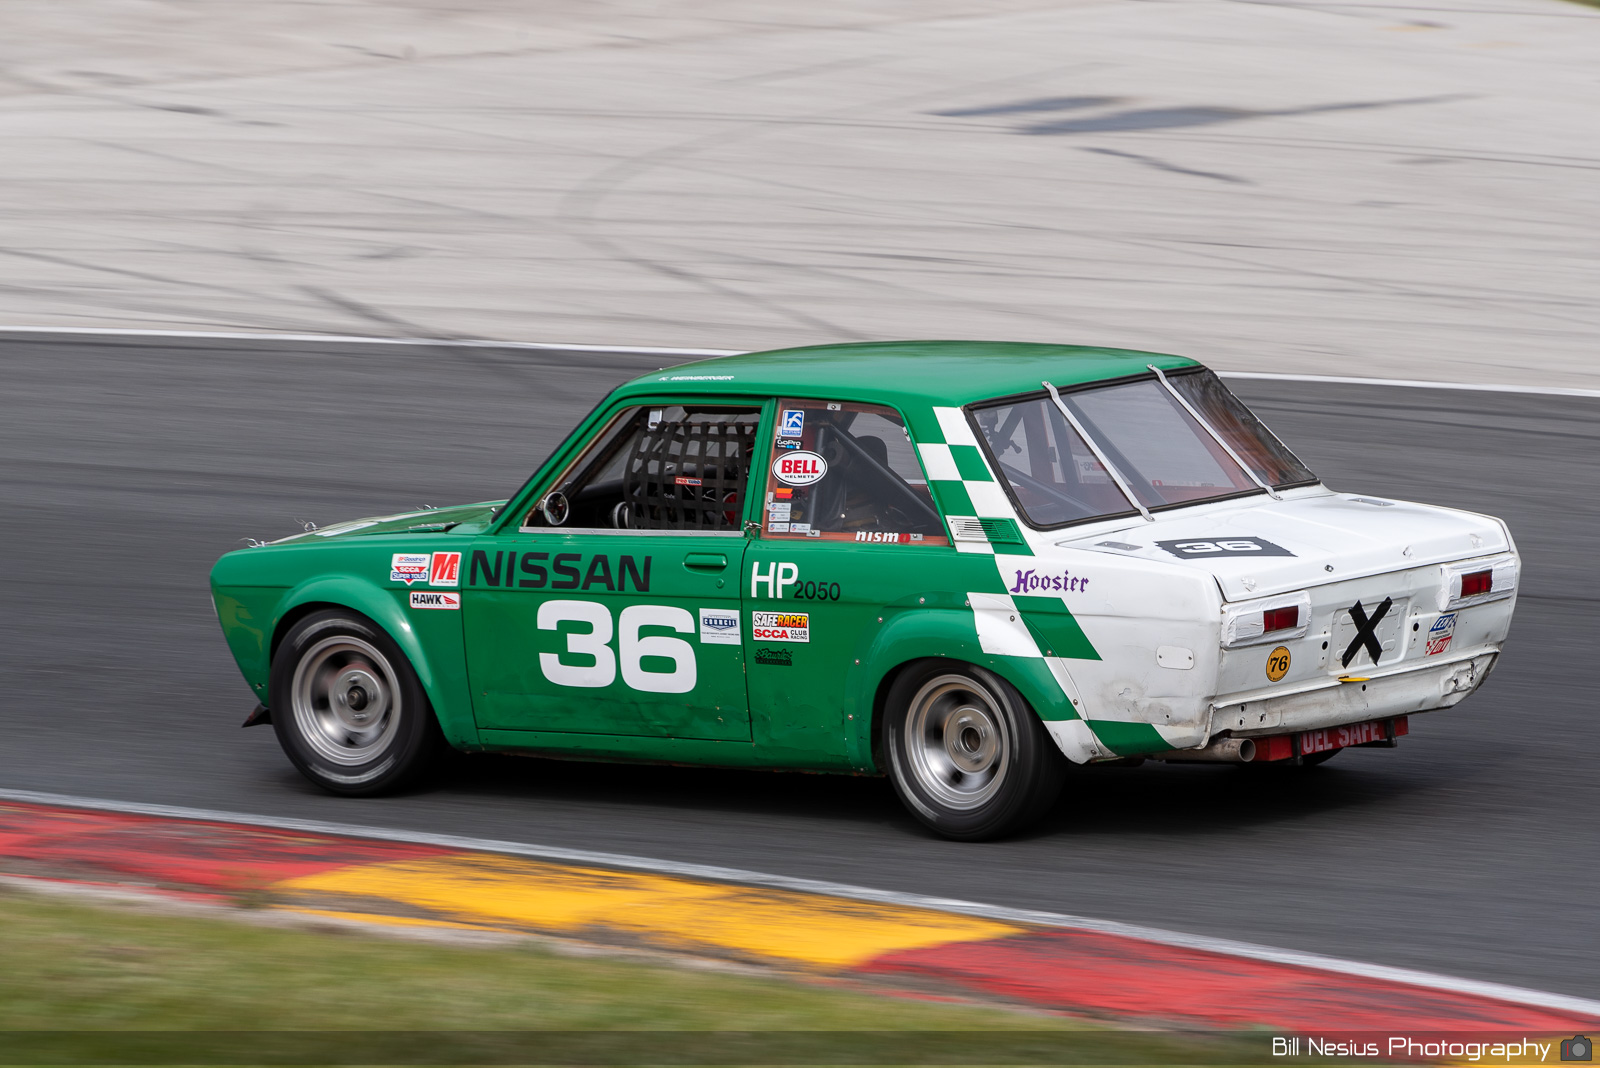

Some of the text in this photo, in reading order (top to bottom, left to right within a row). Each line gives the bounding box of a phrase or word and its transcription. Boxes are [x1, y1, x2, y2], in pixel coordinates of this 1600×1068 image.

[781, 459, 819, 474] BELL
[855, 531, 911, 543] nismo
[1174, 541, 1263, 555] 36
[392, 571, 427, 580] SUPER TOUR
[469, 549, 652, 592] NISSAN
[751, 561, 841, 601] HP 2050
[1009, 569, 1089, 594] Hoosier
[412, 593, 442, 605] HAWK
[704, 618, 736, 626] COUNCIL
[754, 613, 808, 628] SAFERACER
[754, 628, 789, 639] SCCA
[537, 599, 697, 694] 36
[1269, 655, 1288, 673] 76
[1302, 722, 1380, 754] UEL SAFE
